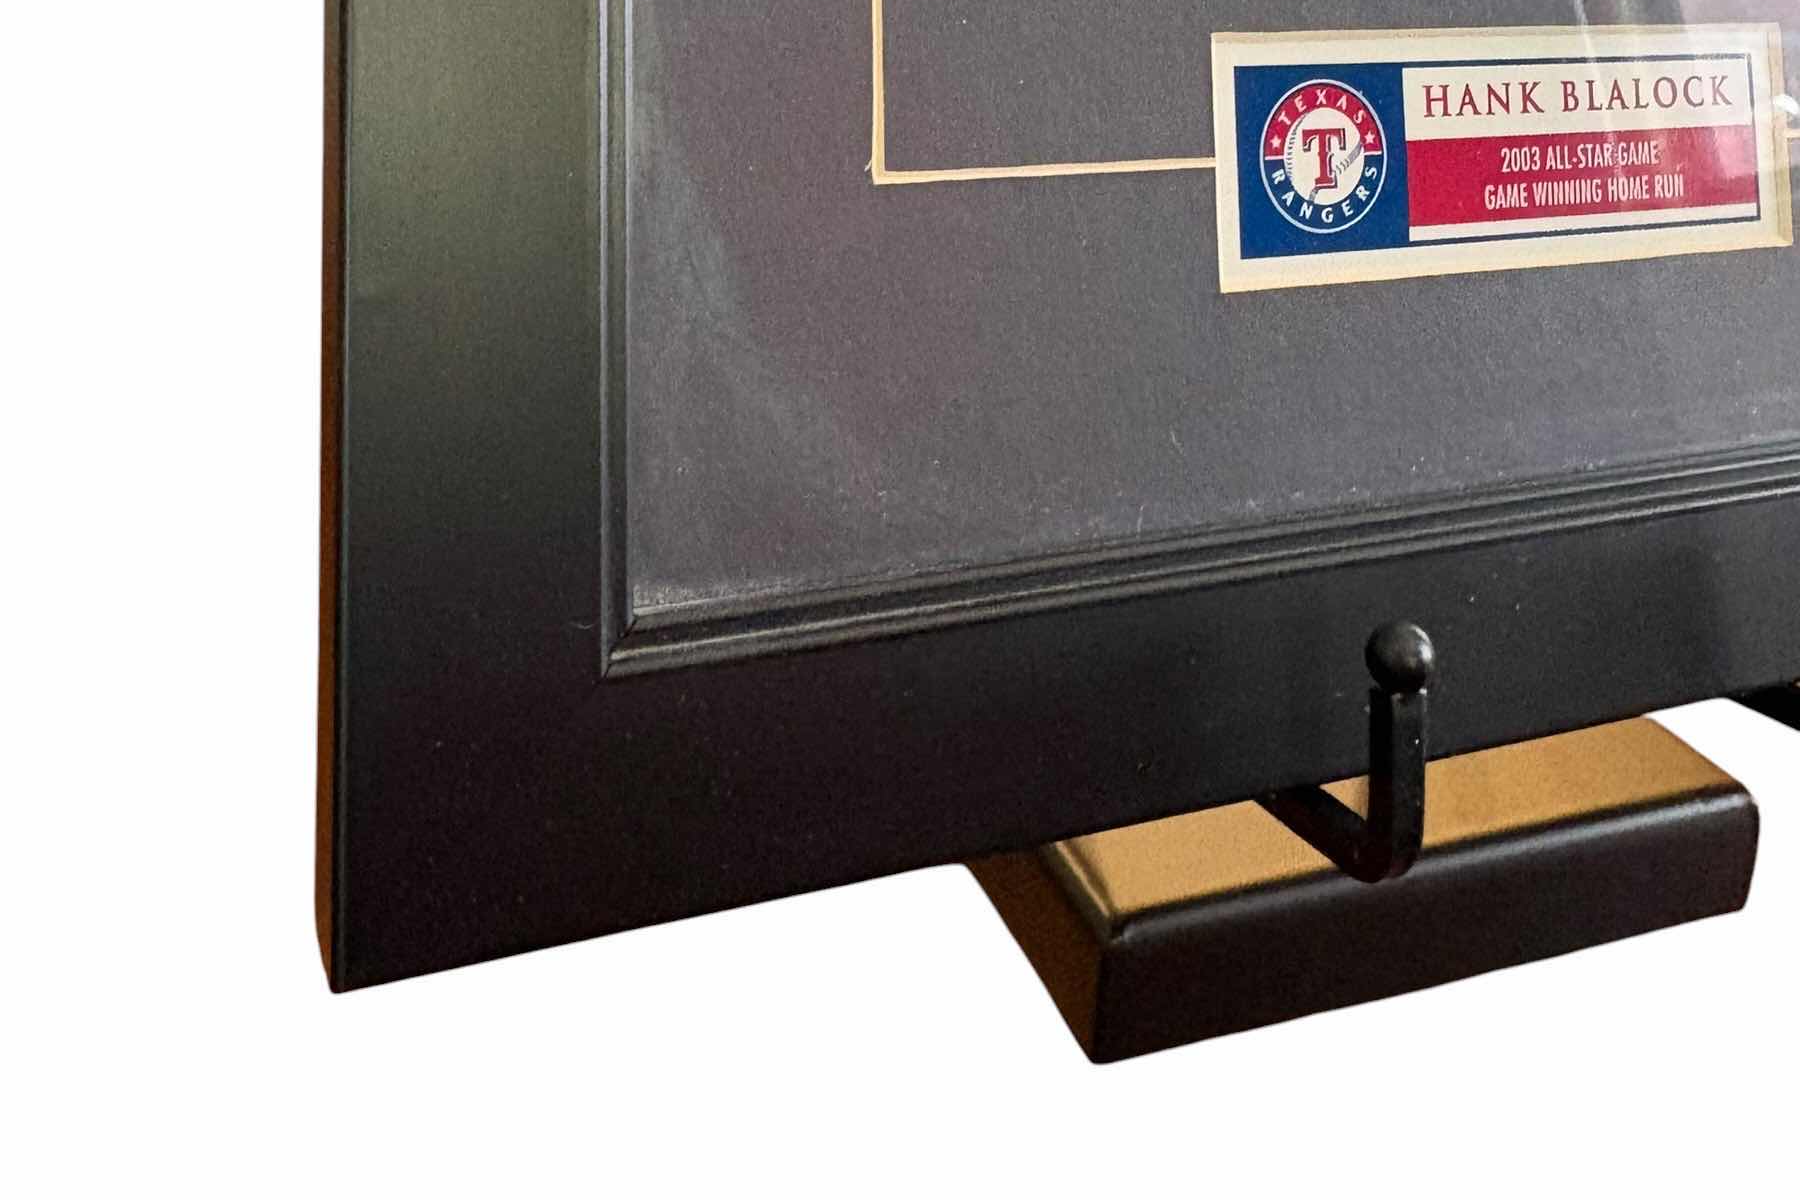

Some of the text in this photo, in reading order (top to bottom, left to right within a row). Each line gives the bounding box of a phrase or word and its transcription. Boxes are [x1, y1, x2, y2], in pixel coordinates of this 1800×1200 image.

[1278, 89, 1367, 126] TEXAS
[1422, 75, 1733, 118] HANK BLALOCK
[1302, 128, 1346, 189] T
[1501, 140, 1660, 173] 2003 ALL-STAR GAME
[1272, 167, 1378, 224] RANGERS
[1484, 173, 1684, 210] GAME WINNING HOME RUN
